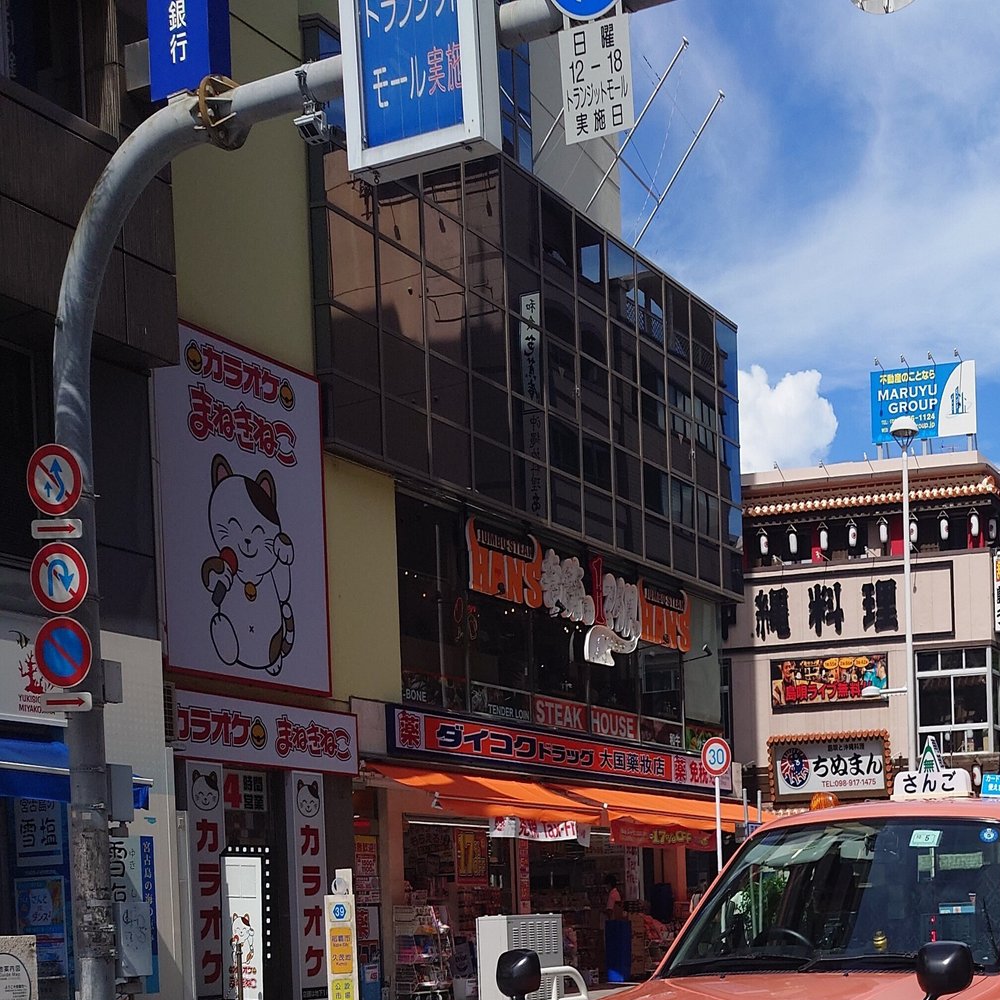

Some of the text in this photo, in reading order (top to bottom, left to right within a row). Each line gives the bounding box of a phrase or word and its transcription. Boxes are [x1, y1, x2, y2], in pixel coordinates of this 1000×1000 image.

[168, 0, 188, 65] 銀行
[573, 23, 615, 57] 日曜
[566, 74, 628, 113] トランジットモール
[575, 103, 623, 137] 実施日
[200, 344, 281, 404] カラオケ
[877, 383, 938, 402] MARUYU
[888, 398, 938, 415] GROUP
[188, 382, 298, 467] まねきねこ
[487, 704, 530, 722] TENDER LOIN
[536, 700, 635, 738] STEAK HOUSE
[275, 713, 352, 762] まねきねこ
[436, 722, 595, 768] ダイコクドラッグ
[599, 747, 667, 782] 大国藥妝店
[708, 748, 725, 766] 30
[812, 752, 883, 778] ちぬまん
[902, 773, 957, 795] さんご
[21, 817, 57, 848] 雪塩
[196, 818, 223, 985] カラオケ
[301, 824, 325, 977] カラオケ
[335, 906, 347, 918] 39
